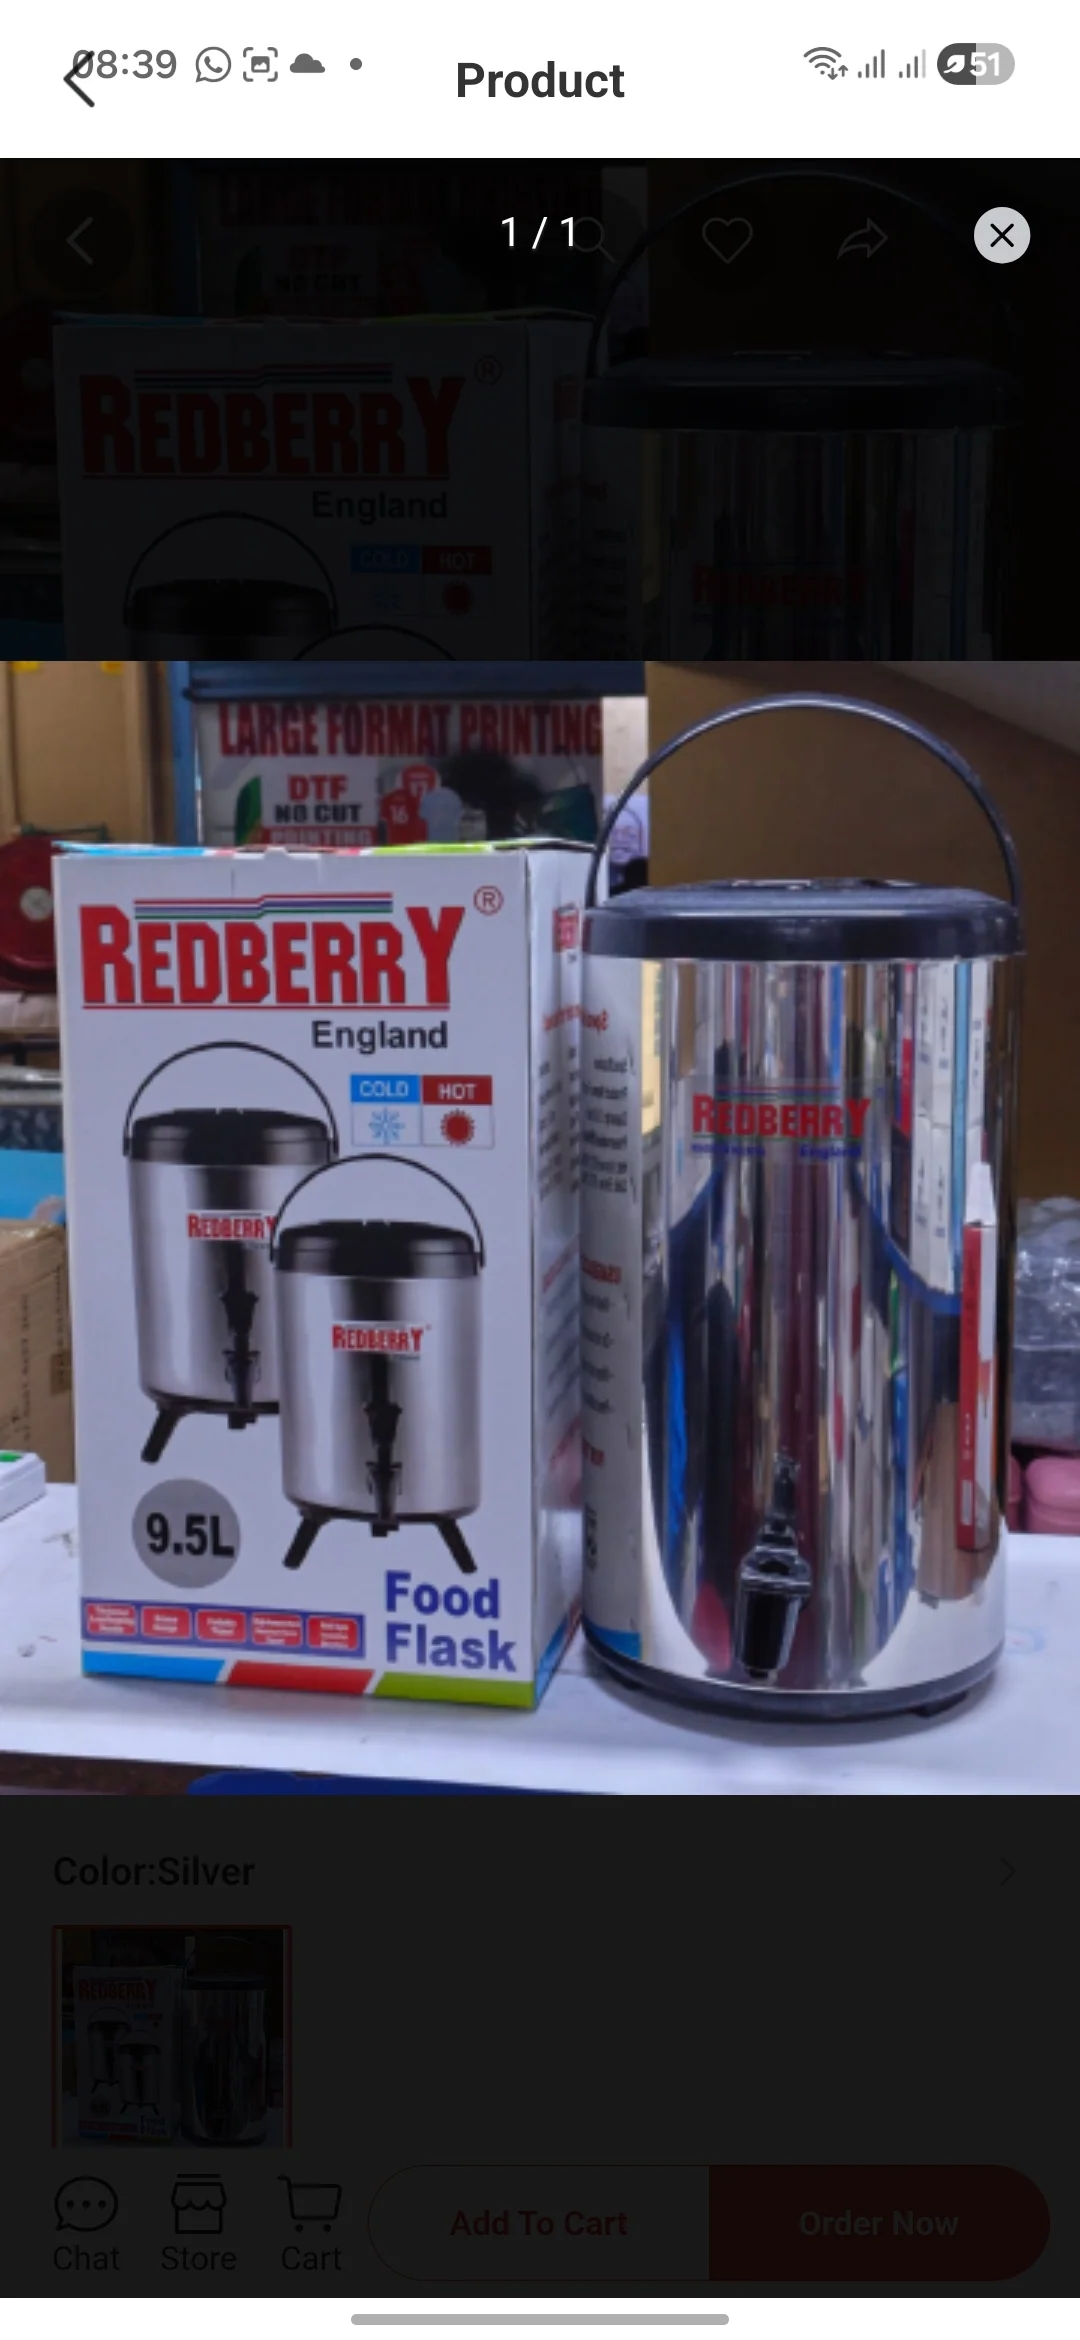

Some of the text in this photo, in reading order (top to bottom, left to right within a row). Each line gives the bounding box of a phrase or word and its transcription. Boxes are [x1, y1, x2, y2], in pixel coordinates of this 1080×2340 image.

[72, 49, 177, 79] 08:39
[970, 52, 1000, 77] 51
[456, 61, 625, 98] Product
[80, 376, 466, 475] REDBERRY
[311, 490, 448, 526] England
[218, 703, 318, 757] LARGE
[326, 704, 453, 757] FORMAT
[288, 774, 350, 802] DTF
[275, 803, 363, 824] NO CUT
[80, 905, 466, 1005] REDBERRY
[311, 1021, 448, 1055] England
[359, 1080, 409, 1098] COLD
[438, 1083, 477, 1100] HOT
[692, 1093, 872, 1138] REDBERRY
[331, 1324, 424, 1353] REDBERRY
[145, 1511, 236, 1560] 9.5L
[384, 1568, 501, 1620] Food
[384, 1621, 518, 1675] Flask
[449, 2210, 628, 2236] Add To Cart
[799, 2210, 959, 2236] Order Now
[53, 2245, 120, 2271] Chat
[160, 2245, 238, 2271] Store
[281, 2245, 342, 2271] Cart
